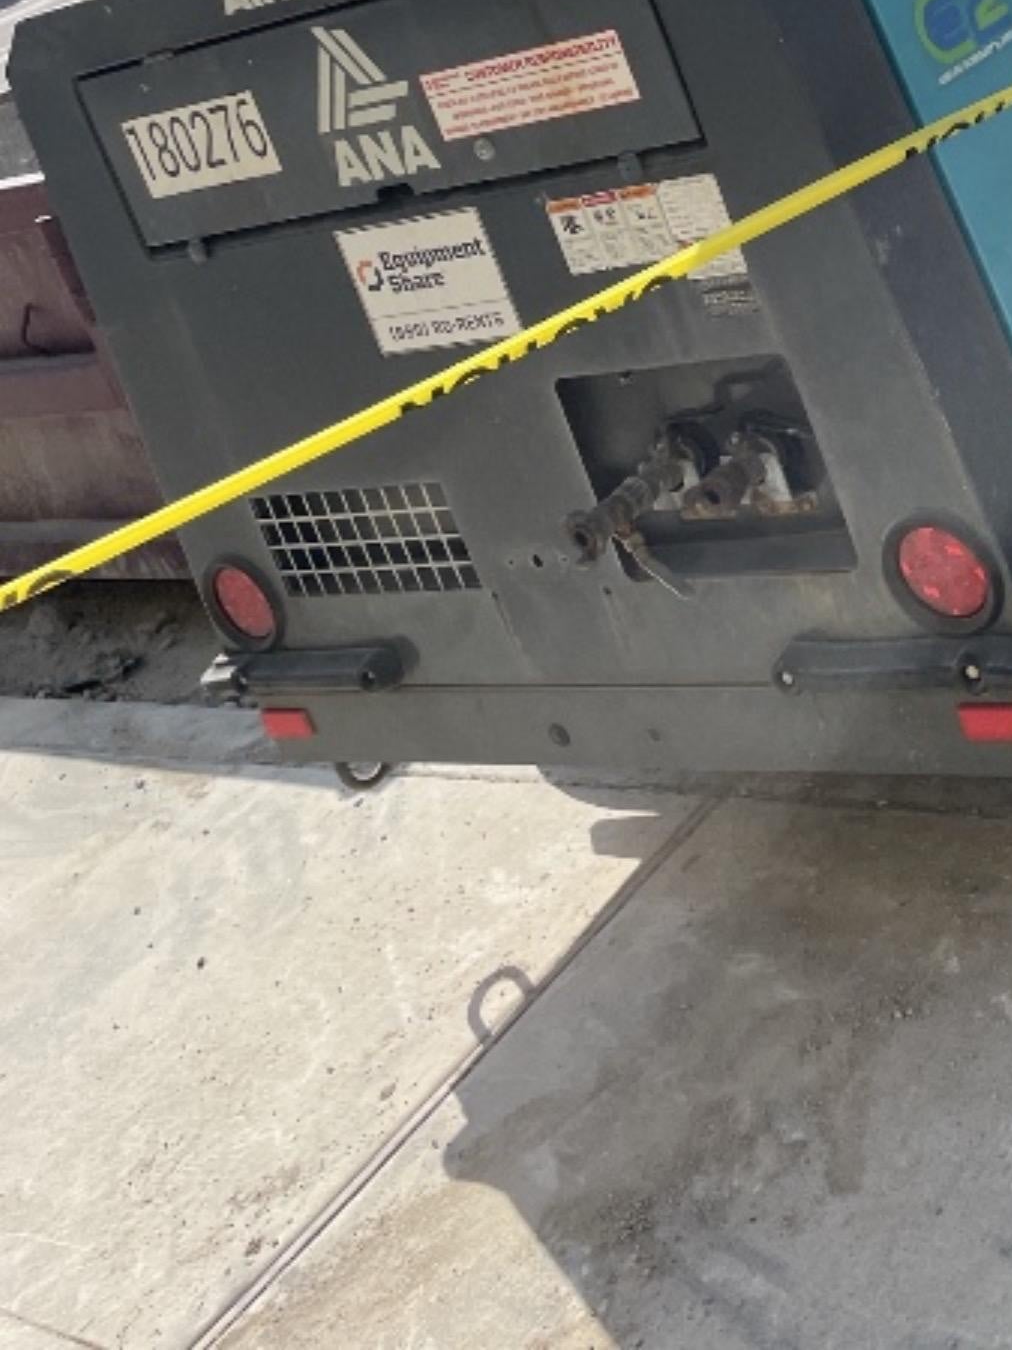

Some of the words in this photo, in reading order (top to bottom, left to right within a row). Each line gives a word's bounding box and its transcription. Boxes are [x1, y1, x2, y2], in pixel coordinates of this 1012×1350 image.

[125, 98, 268, 181] 180276
[333, 125, 441, 188] ANA
[377, 237, 487, 274] Equipment
[386, 271, 446, 294] Share
